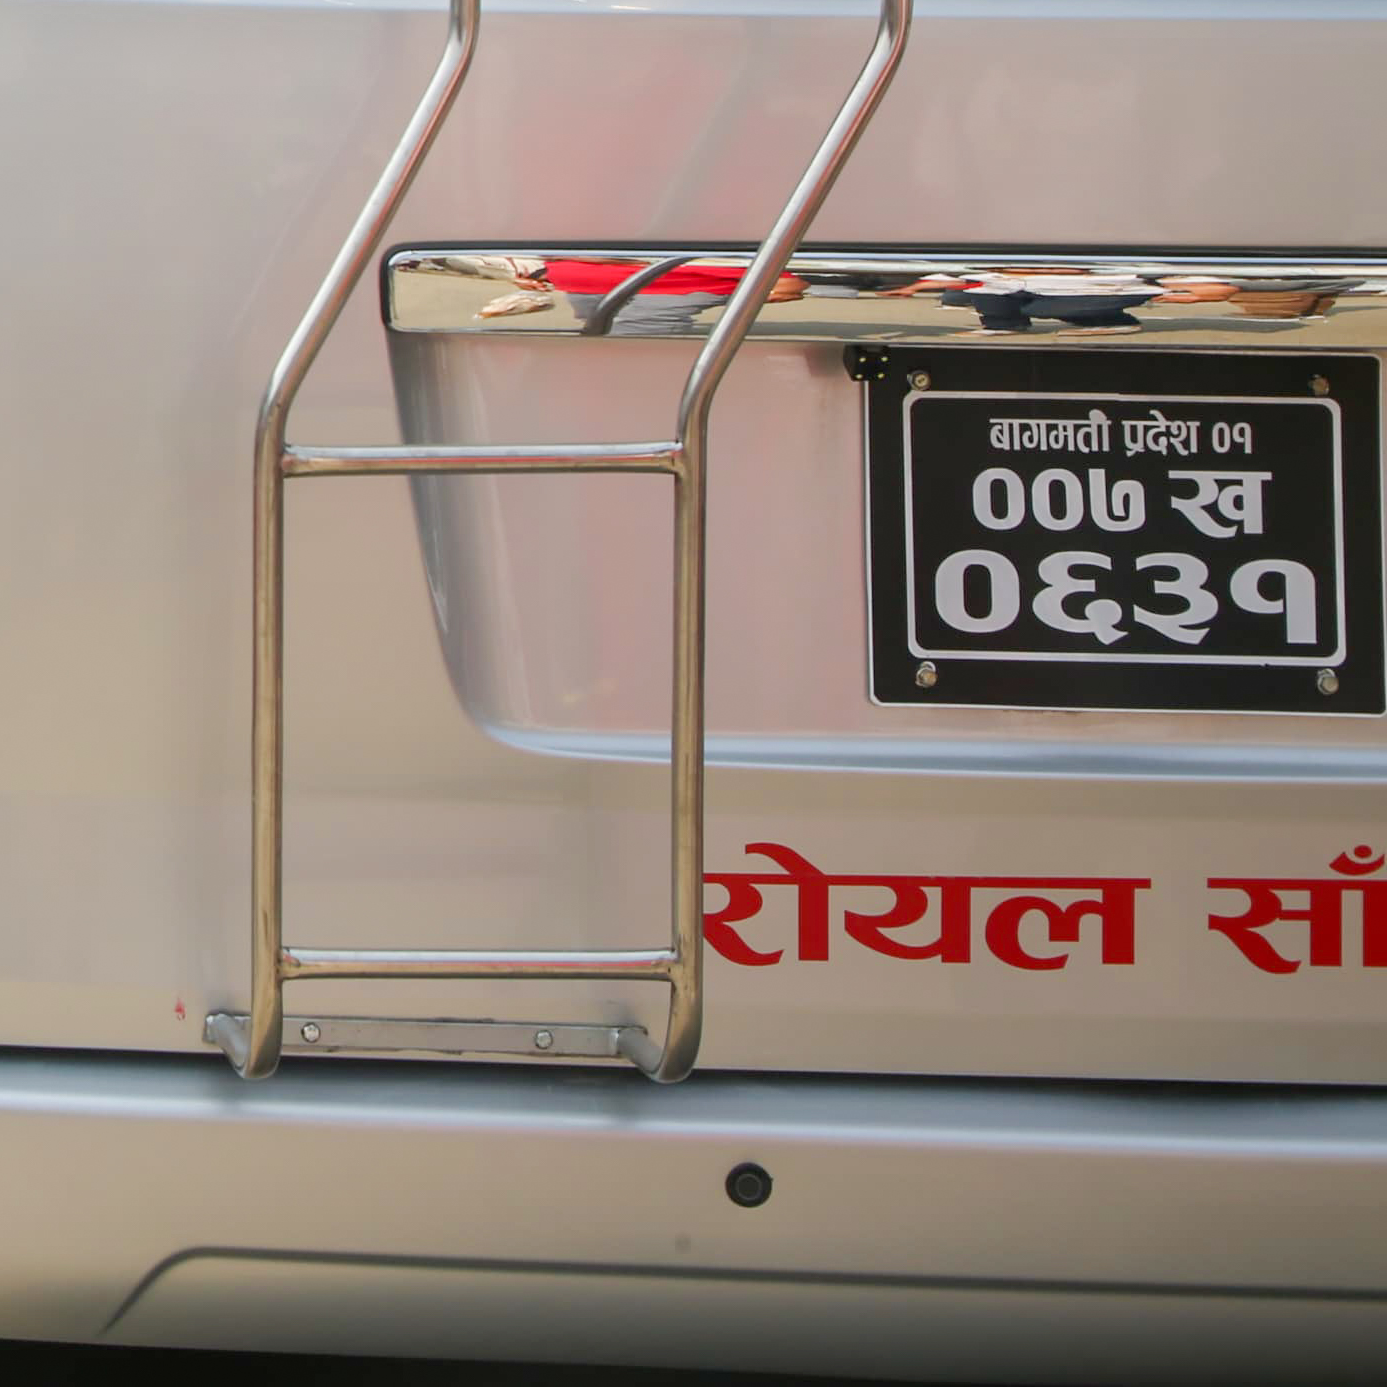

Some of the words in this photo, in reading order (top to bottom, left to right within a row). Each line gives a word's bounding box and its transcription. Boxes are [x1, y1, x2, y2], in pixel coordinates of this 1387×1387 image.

[989, 409, 1110, 453] बागमती
[1122, 410, 1199, 457] प्रदेश
[1212, 421, 1253, 454] ०१
[972, 466, 1146, 531] ००७
[1168, 471, 1272, 539] ख
[935, 549, 1318, 645] ०६३१
[703, 841, 1151, 971] रोयल
